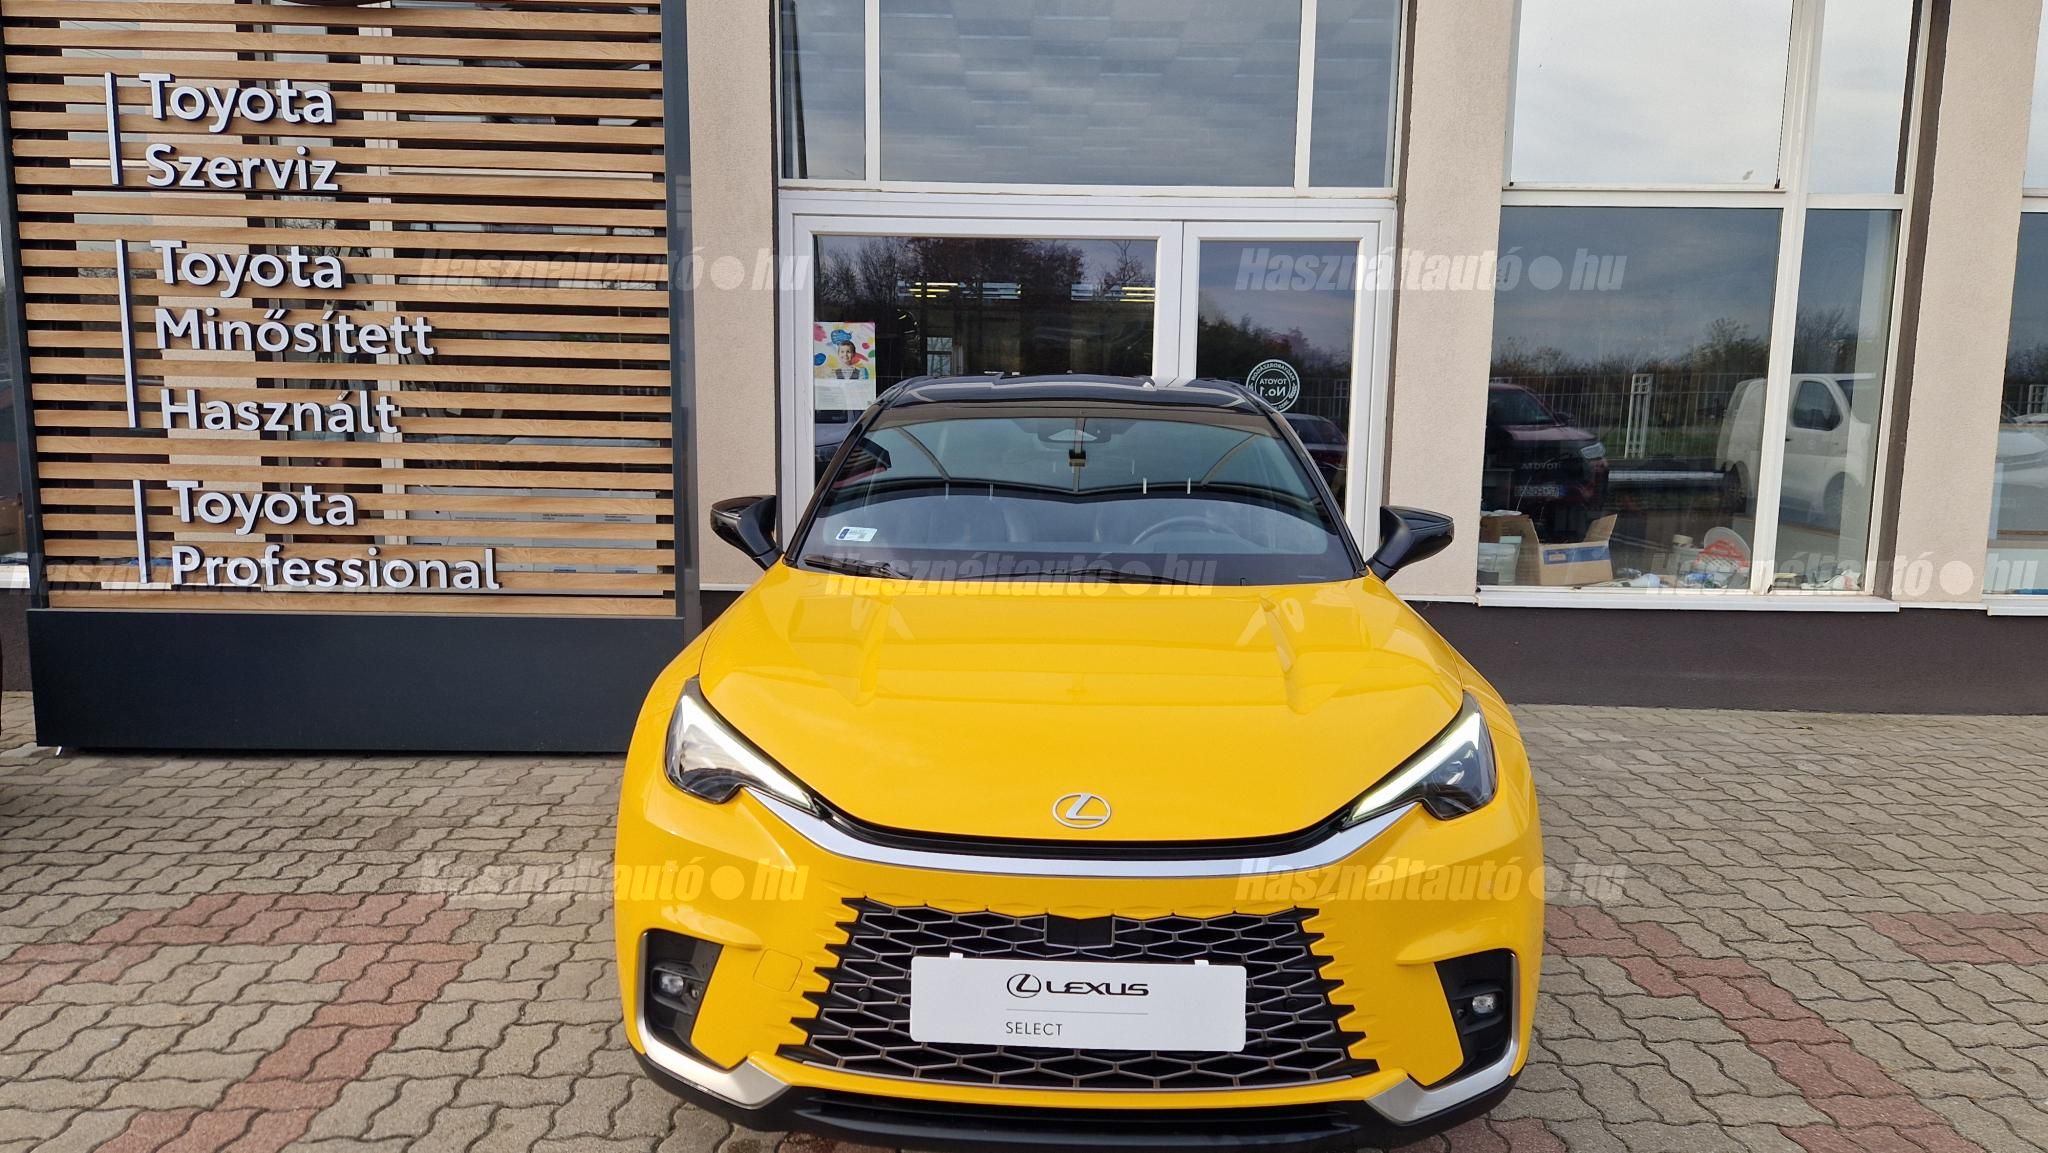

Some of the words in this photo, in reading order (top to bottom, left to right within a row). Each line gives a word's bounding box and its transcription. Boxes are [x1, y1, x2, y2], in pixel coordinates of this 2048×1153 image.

[138, 72, 336, 132] Toyota
[145, 144, 340, 191] Szerviz
[150, 239, 344, 297] Toyota
[155, 308, 435, 355] Minősített
[161, 389, 401, 434] Használt
[167, 480, 358, 535] Toyota
[172, 545, 500, 590] Professional
[1046, 980, 1149, 996] LEXUS
[1005, 1021, 1063, 1036] SELECT
